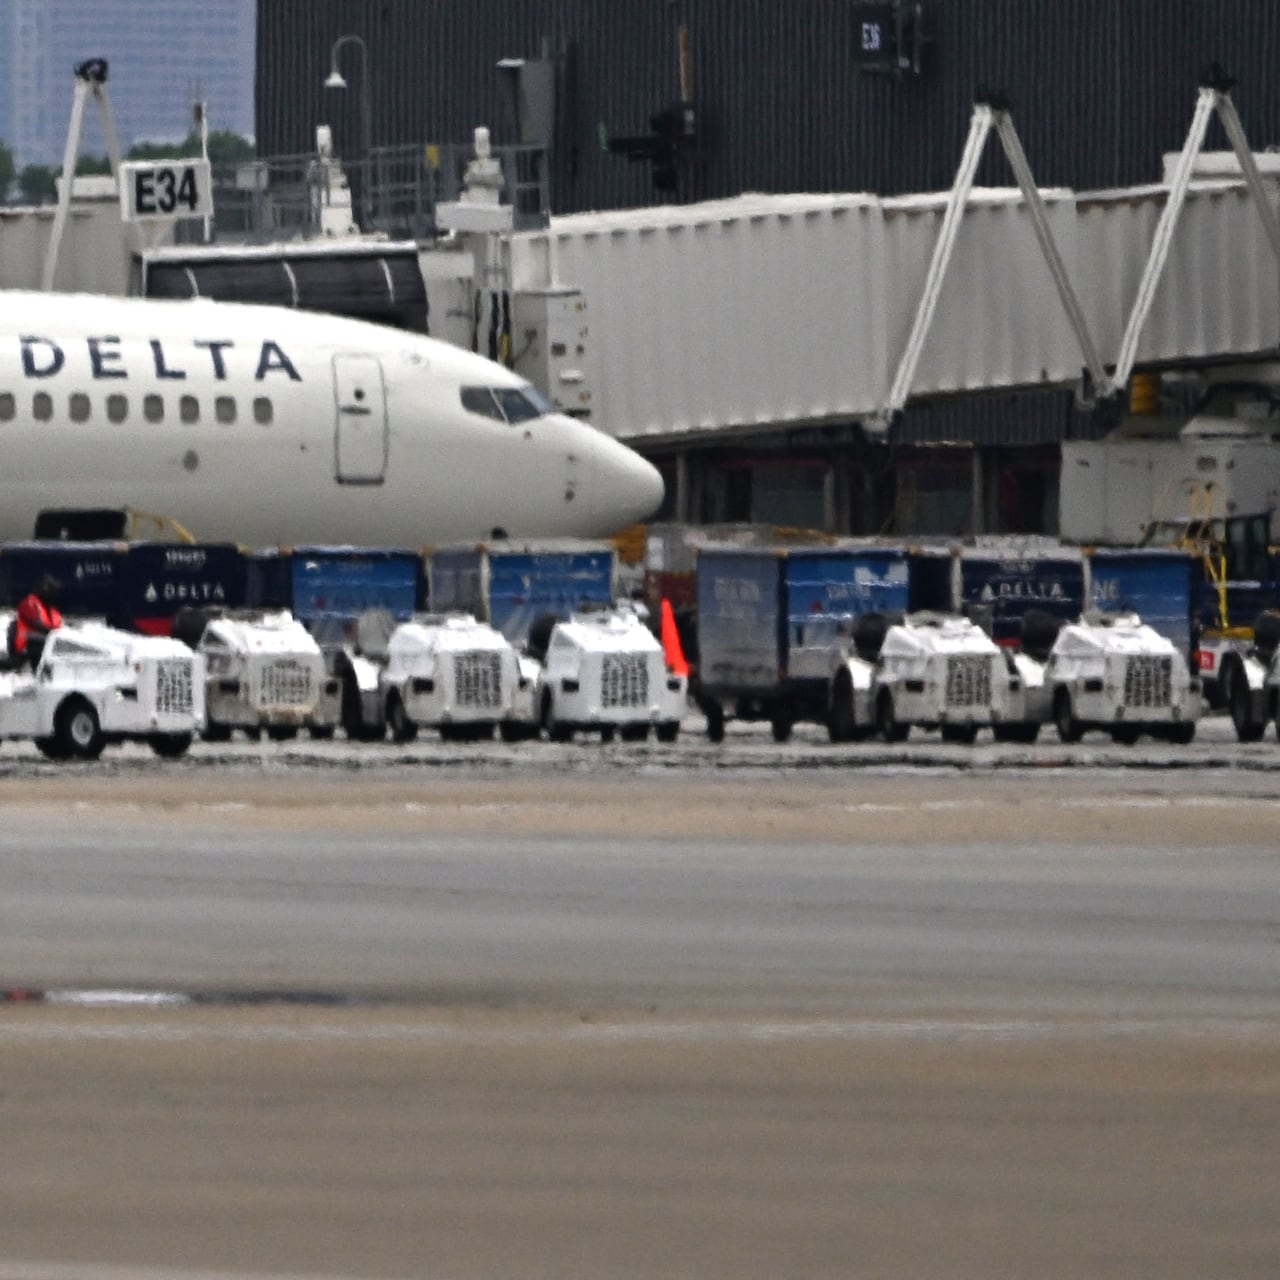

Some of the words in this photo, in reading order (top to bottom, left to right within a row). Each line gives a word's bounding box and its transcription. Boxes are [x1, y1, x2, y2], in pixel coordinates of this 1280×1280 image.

[135, 166, 197, 214] E34
[19, 336, 302, 381] DELTA
[163, 582, 225, 601] DELTA
[999, 580, 1065, 598] DELTA
